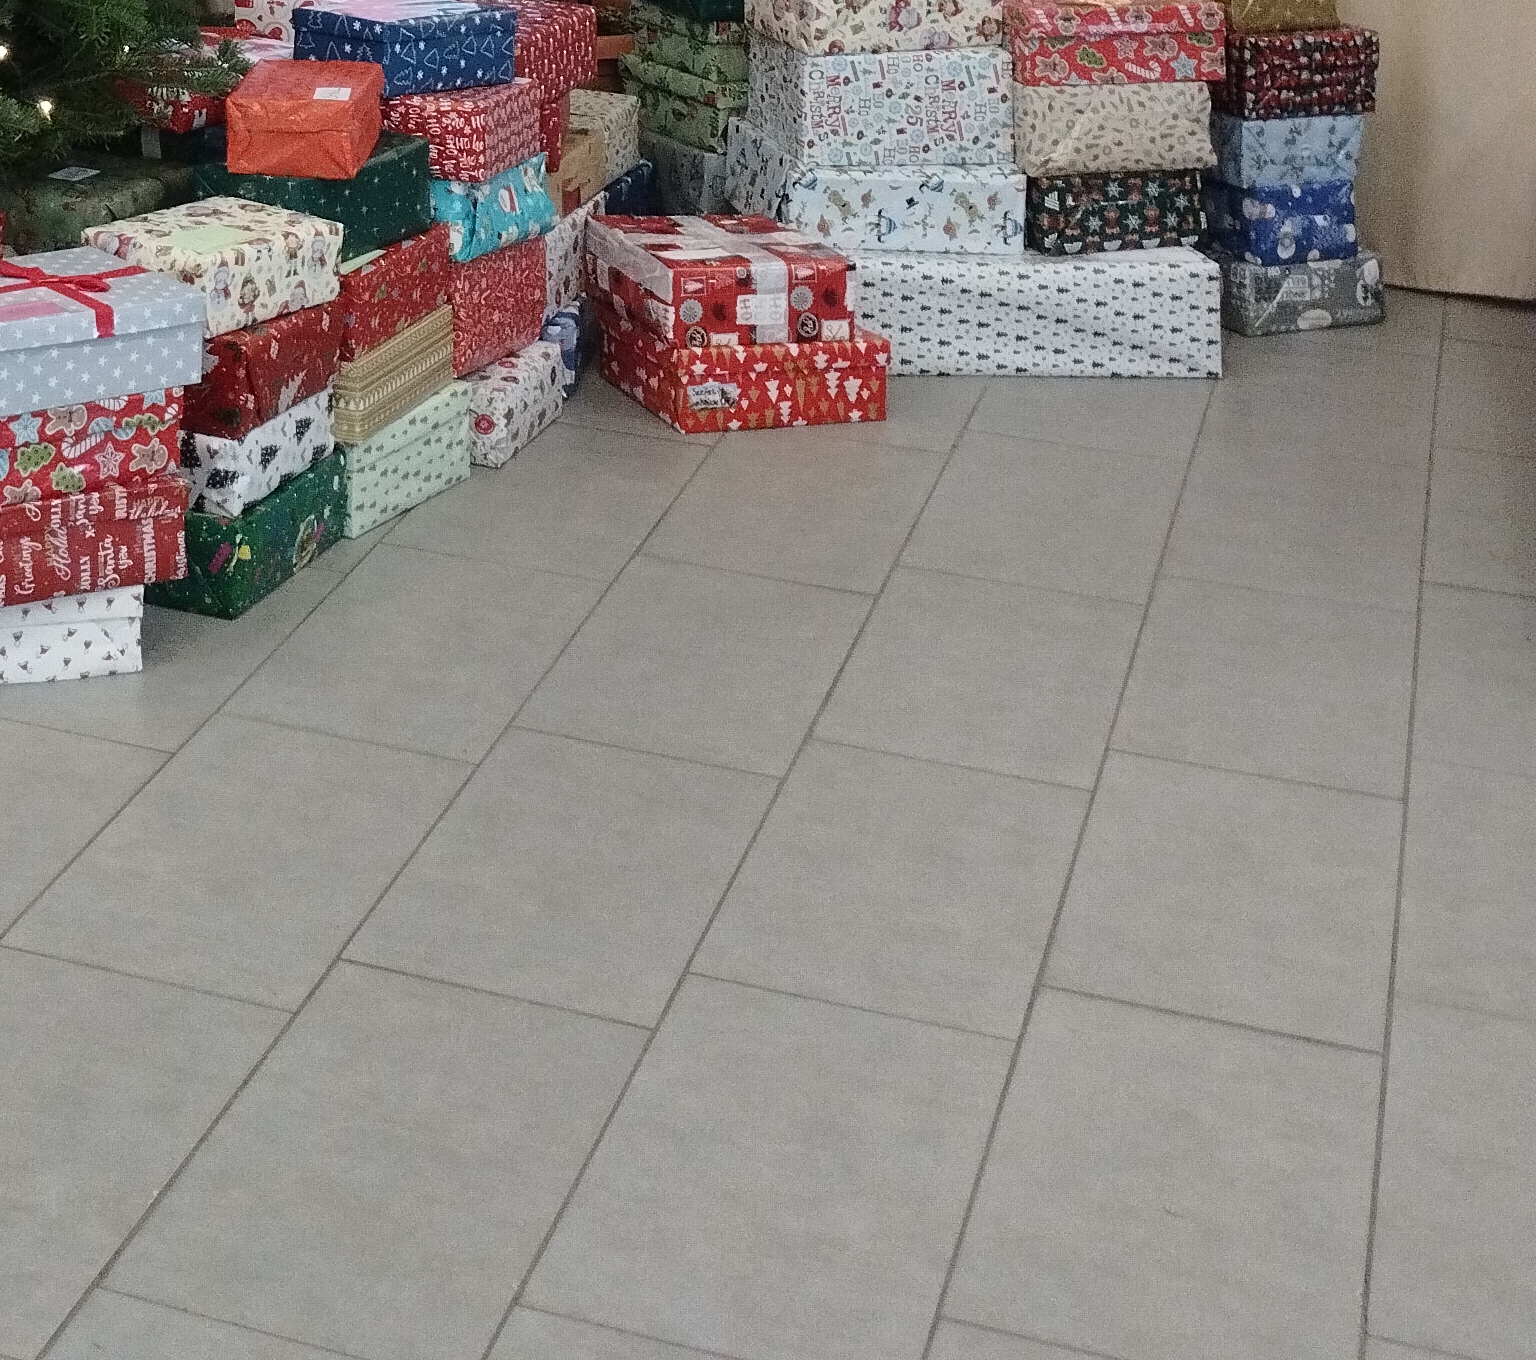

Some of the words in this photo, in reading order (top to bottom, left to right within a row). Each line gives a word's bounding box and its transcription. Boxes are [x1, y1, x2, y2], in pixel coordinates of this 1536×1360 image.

[13, 535, 43, 595] Greetings
[97, 533, 121, 589] Santa
[141, 517, 157, 585] CHRISTMAS
